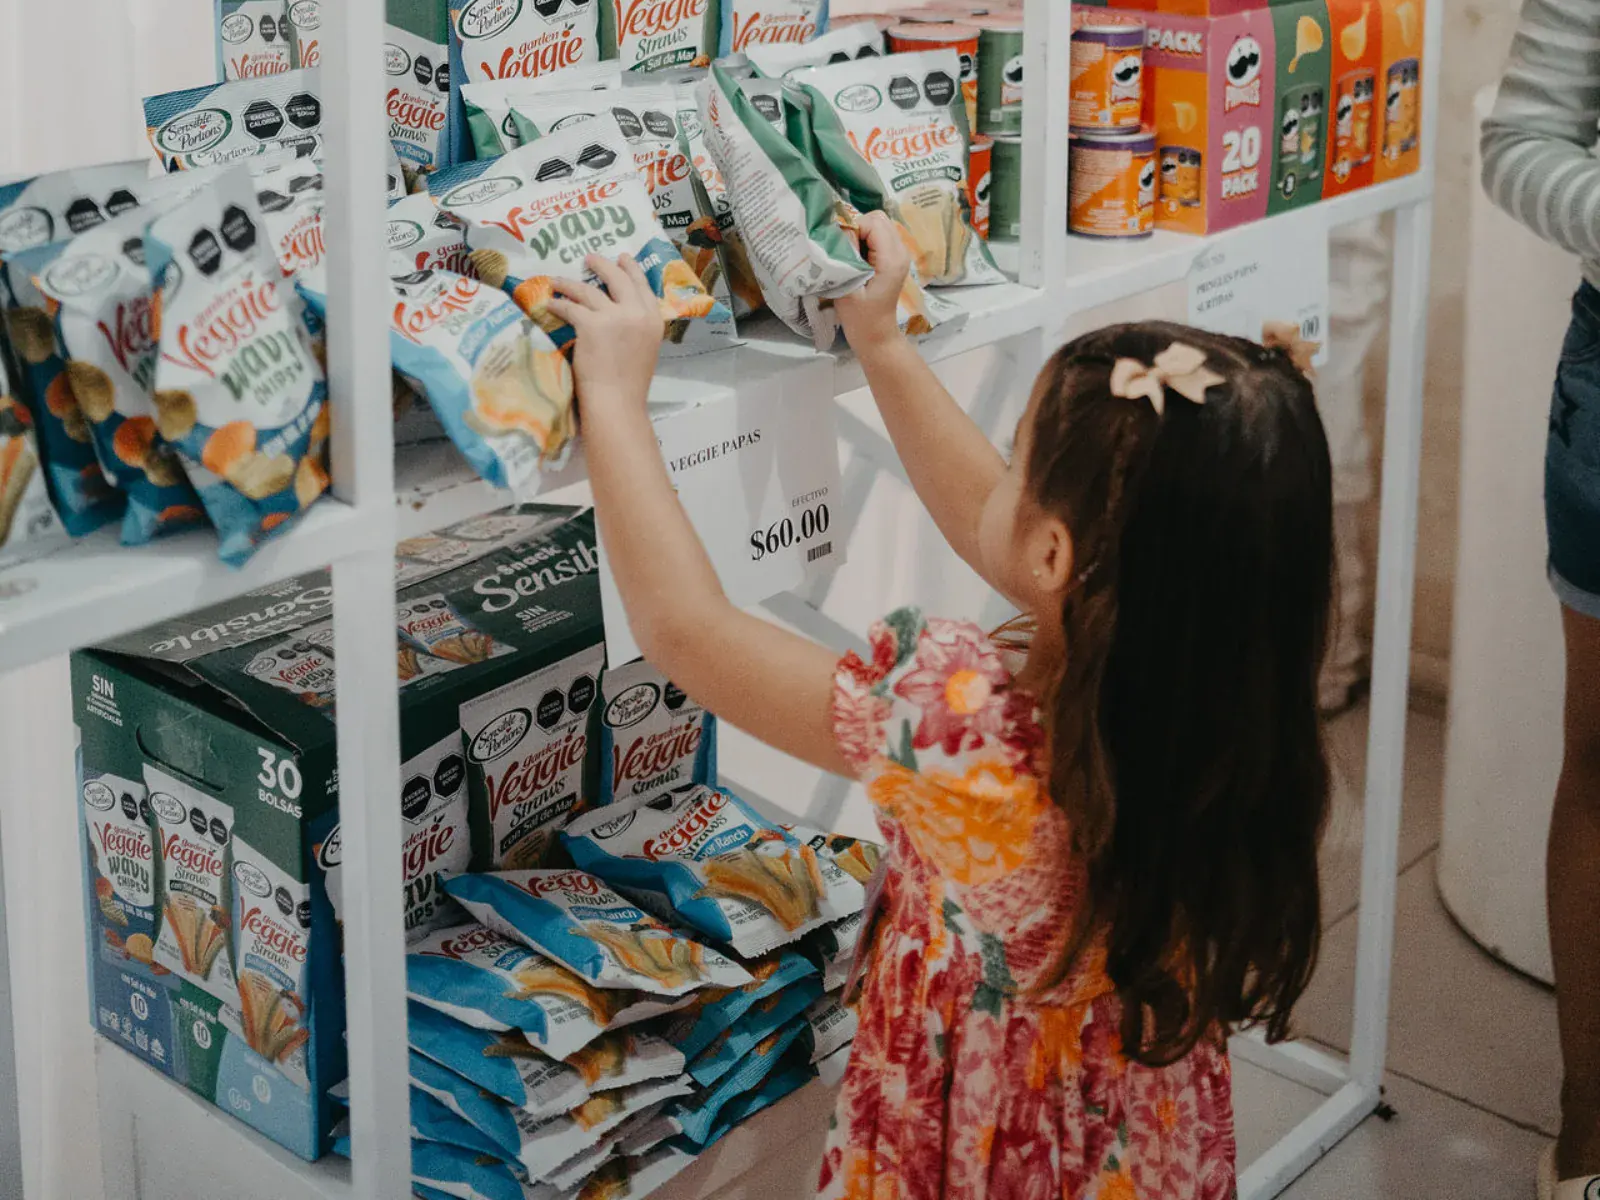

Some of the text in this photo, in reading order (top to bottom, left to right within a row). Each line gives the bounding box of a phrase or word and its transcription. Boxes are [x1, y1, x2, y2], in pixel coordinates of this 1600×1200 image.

[477, 4, 515, 34] Portions
[519, 29, 560, 59] garden
[635, 27, 688, 61] Straws
[1149, 28, 1203, 53] PACK
[480, 36, 584, 80] Veggie
[648, 49, 696, 71] Sal de Mar
[167, 112, 212, 141] Sensible
[178, 124, 222, 150] Portions
[388, 123, 427, 144] Straws
[886, 124, 925, 137] garden
[847, 125, 957, 165] Veggie
[1221, 125, 1262, 174] 20
[892, 150, 950, 173] Straws
[894, 178, 913, 190] con
[915, 172, 930, 182] Sal
[1221, 171, 1258, 200] PACK
[530, 187, 582, 212] garden
[666, 214, 690, 226] Mar
[559, 232, 617, 264] CHIPS
[161, 278, 284, 378] Veggie
[669, 429, 762, 473] VEGGIE PAPAS
[790, 486, 829, 508] EFECTIVO
[750, 503, 830, 562] $60.00
[473, 539, 600, 613] Sensib
[397, 611, 455, 636] Veggie
[515, 604, 547, 621] SIN
[270, 656, 323, 684] Veggie
[92, 674, 114, 699] SIN
[478, 713, 516, 750] Sensible
[485, 724, 524, 756] Portions
[644, 725, 683, 750] garden
[522, 737, 562, 771] garden
[613, 726, 702, 795] Veggie
[257, 746, 303, 799] 30
[485, 734, 587, 823] Veggie
[258, 788, 303, 820] BOLSAS
[510, 778, 566, 828] Straws
[113, 825, 136, 837] garden
[502, 797, 573, 851] con Sal de Mar
[622, 792, 730, 862] Veggie
[659, 805, 695, 840] garden
[677, 814, 728, 860] Straws
[94, 821, 152, 861] Veggie
[160, 827, 224, 878] Veggie
[181, 839, 207, 854] garden
[717, 829, 748, 849] Ranch
[107, 855, 150, 894] wavy
[117, 875, 142, 893] CHIPS
[174, 863, 211, 888] Straws
[506, 873, 600, 898] Vegg
[240, 895, 307, 964] Veggie
[263, 915, 291, 936] garden
[251, 939, 290, 970] Straws
[133, 994, 146, 1014] 10
[195, 1022, 209, 1043] 10
